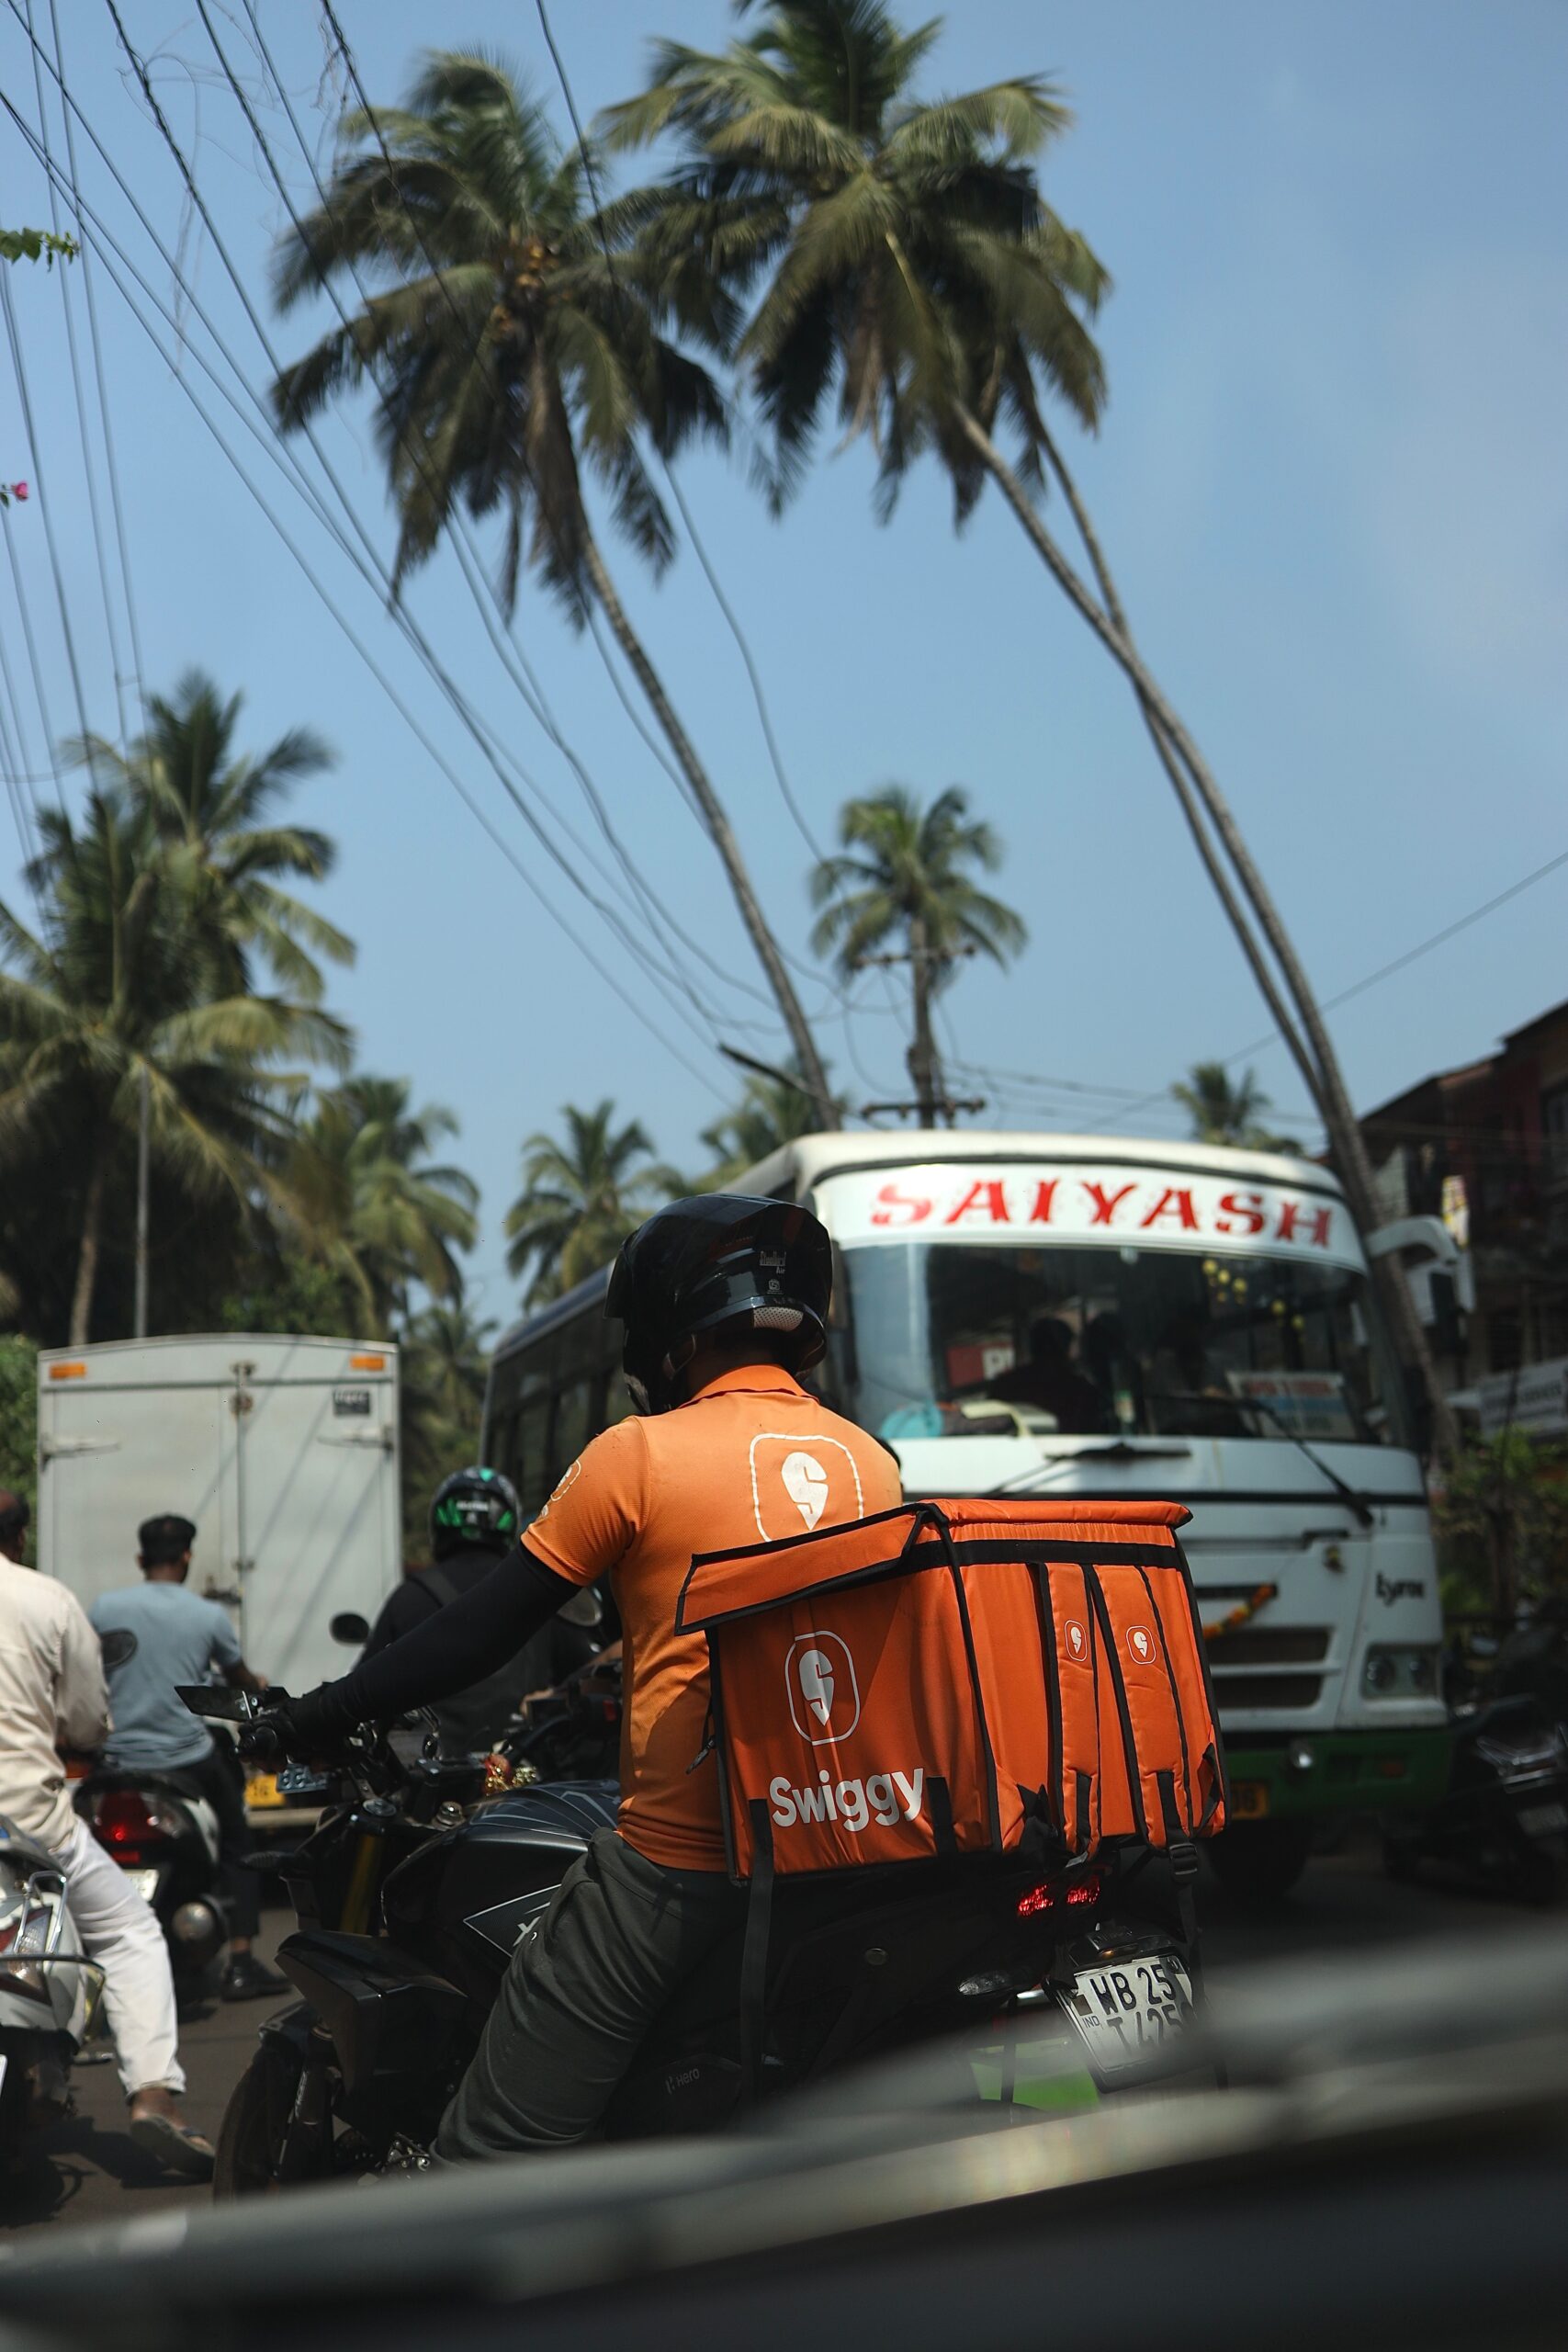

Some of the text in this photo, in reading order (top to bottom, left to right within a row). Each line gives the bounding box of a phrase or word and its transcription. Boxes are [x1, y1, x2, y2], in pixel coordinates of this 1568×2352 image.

[871, 1179, 1332, 1248] SAIYASH
[770, 1768, 924, 1832] Swiggy
[1089, 1963, 1177, 2015] WB 25
[1081, 2015, 1100, 2029] IND
[675, 2067, 700, 2087] Hero
